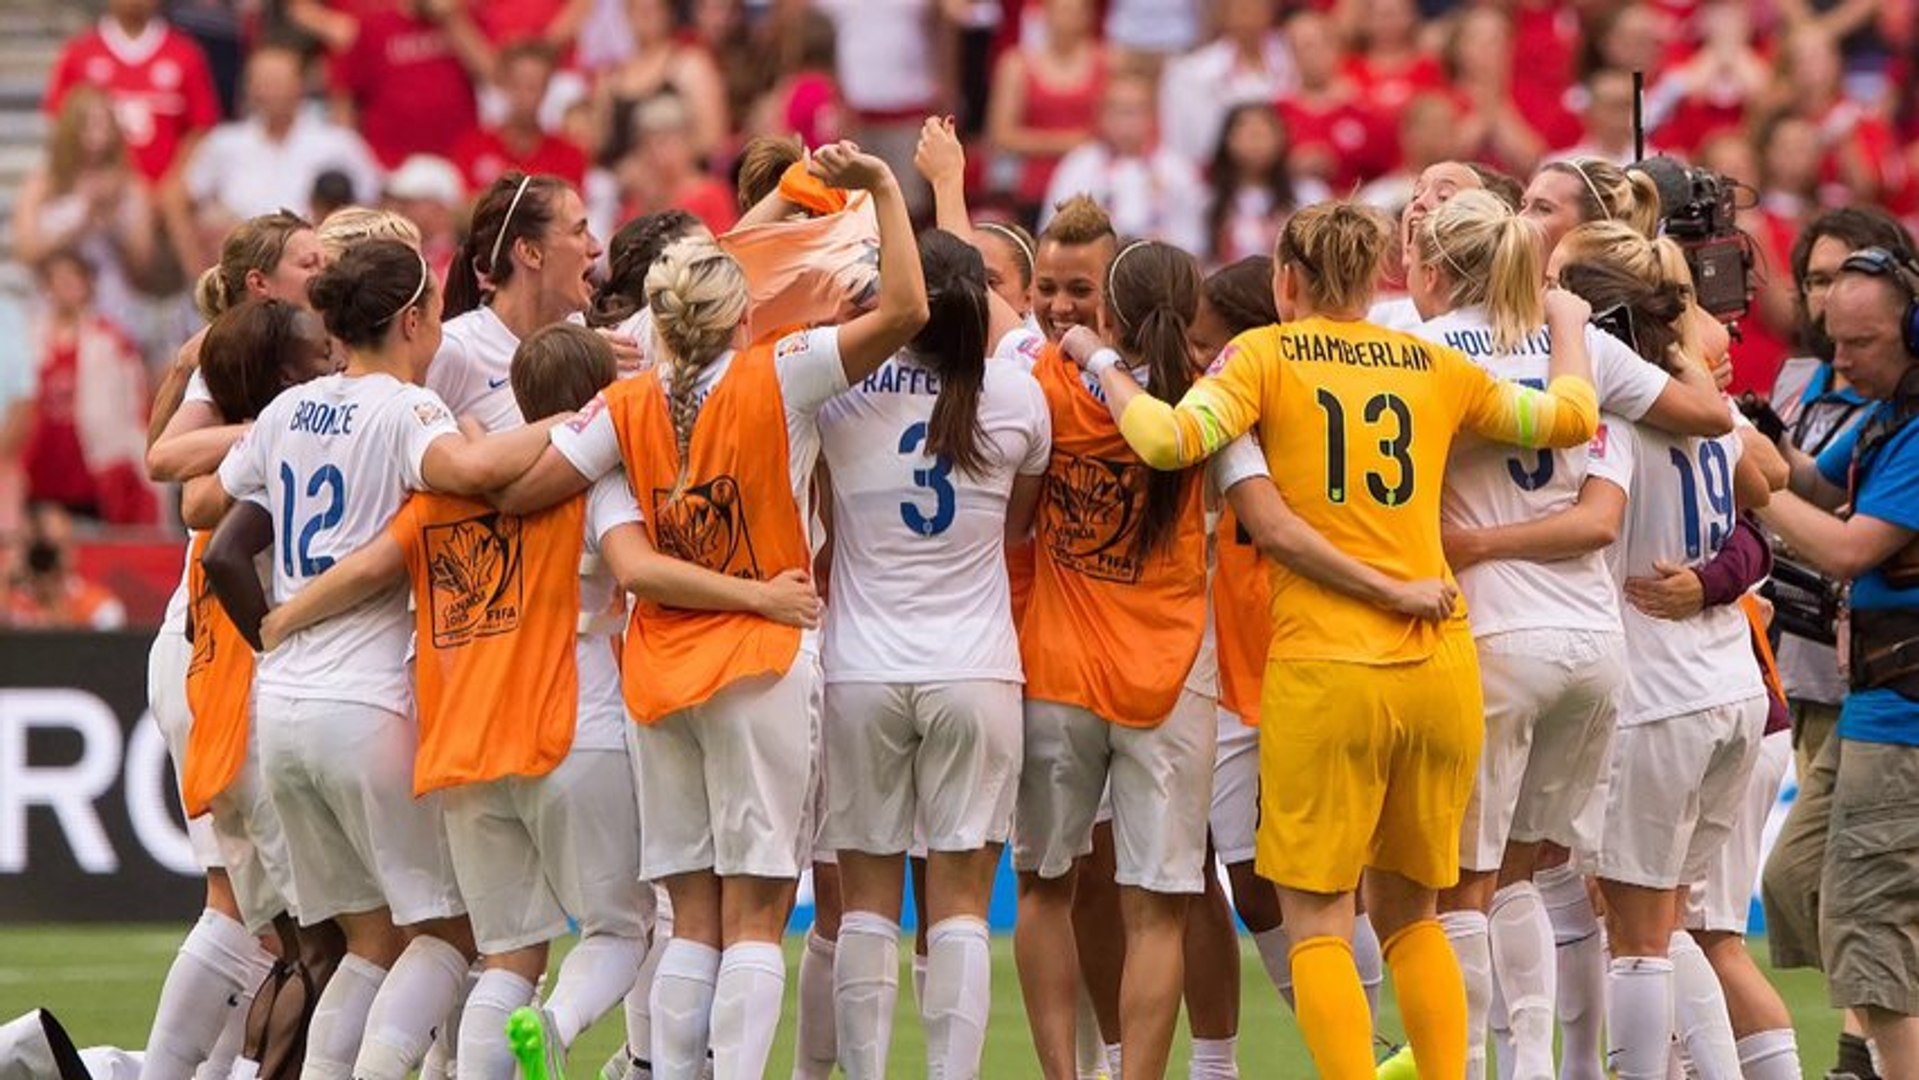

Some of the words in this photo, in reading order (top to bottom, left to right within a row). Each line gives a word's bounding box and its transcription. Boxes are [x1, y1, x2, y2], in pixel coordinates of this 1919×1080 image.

[863, 363, 940, 395] RAFFE
[1281, 334, 1433, 372] CHAMBERLAIN
[290, 400, 358, 435] BRONZE
[1316, 386, 1415, 507] 13
[898, 421, 956, 537] 3
[1669, 439, 1733, 559] 19
[280, 460, 345, 578] 12
[485, 605, 517, 622] FIFA
